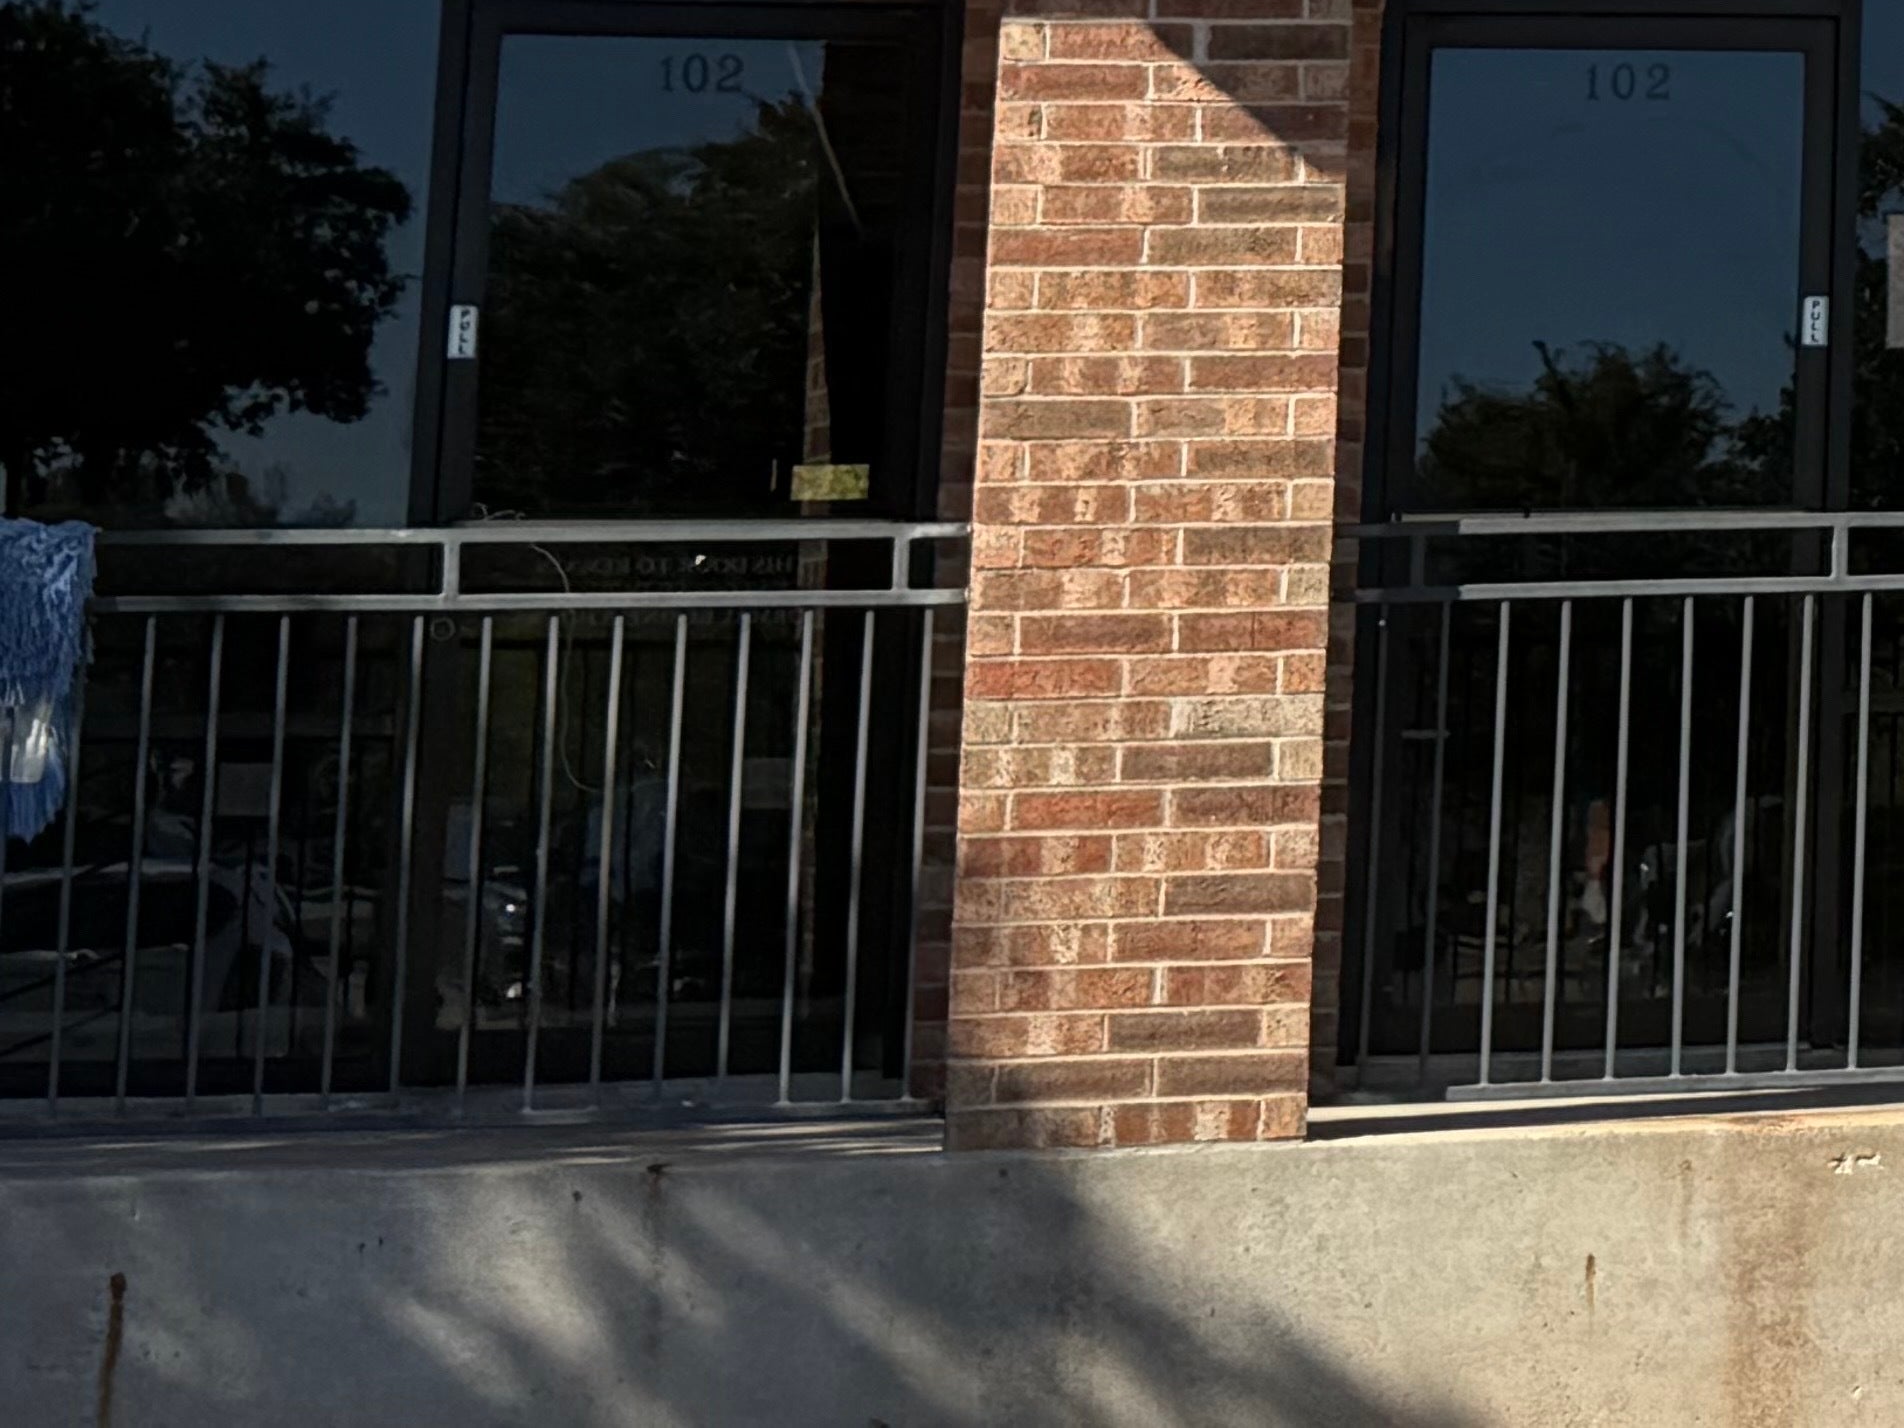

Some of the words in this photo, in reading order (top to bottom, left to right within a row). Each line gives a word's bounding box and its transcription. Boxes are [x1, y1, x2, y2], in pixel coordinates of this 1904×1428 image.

[660, 53, 744, 94] 102
[1586, 61, 1671, 102] 102
[1810, 300, 1821, 343] PULL
